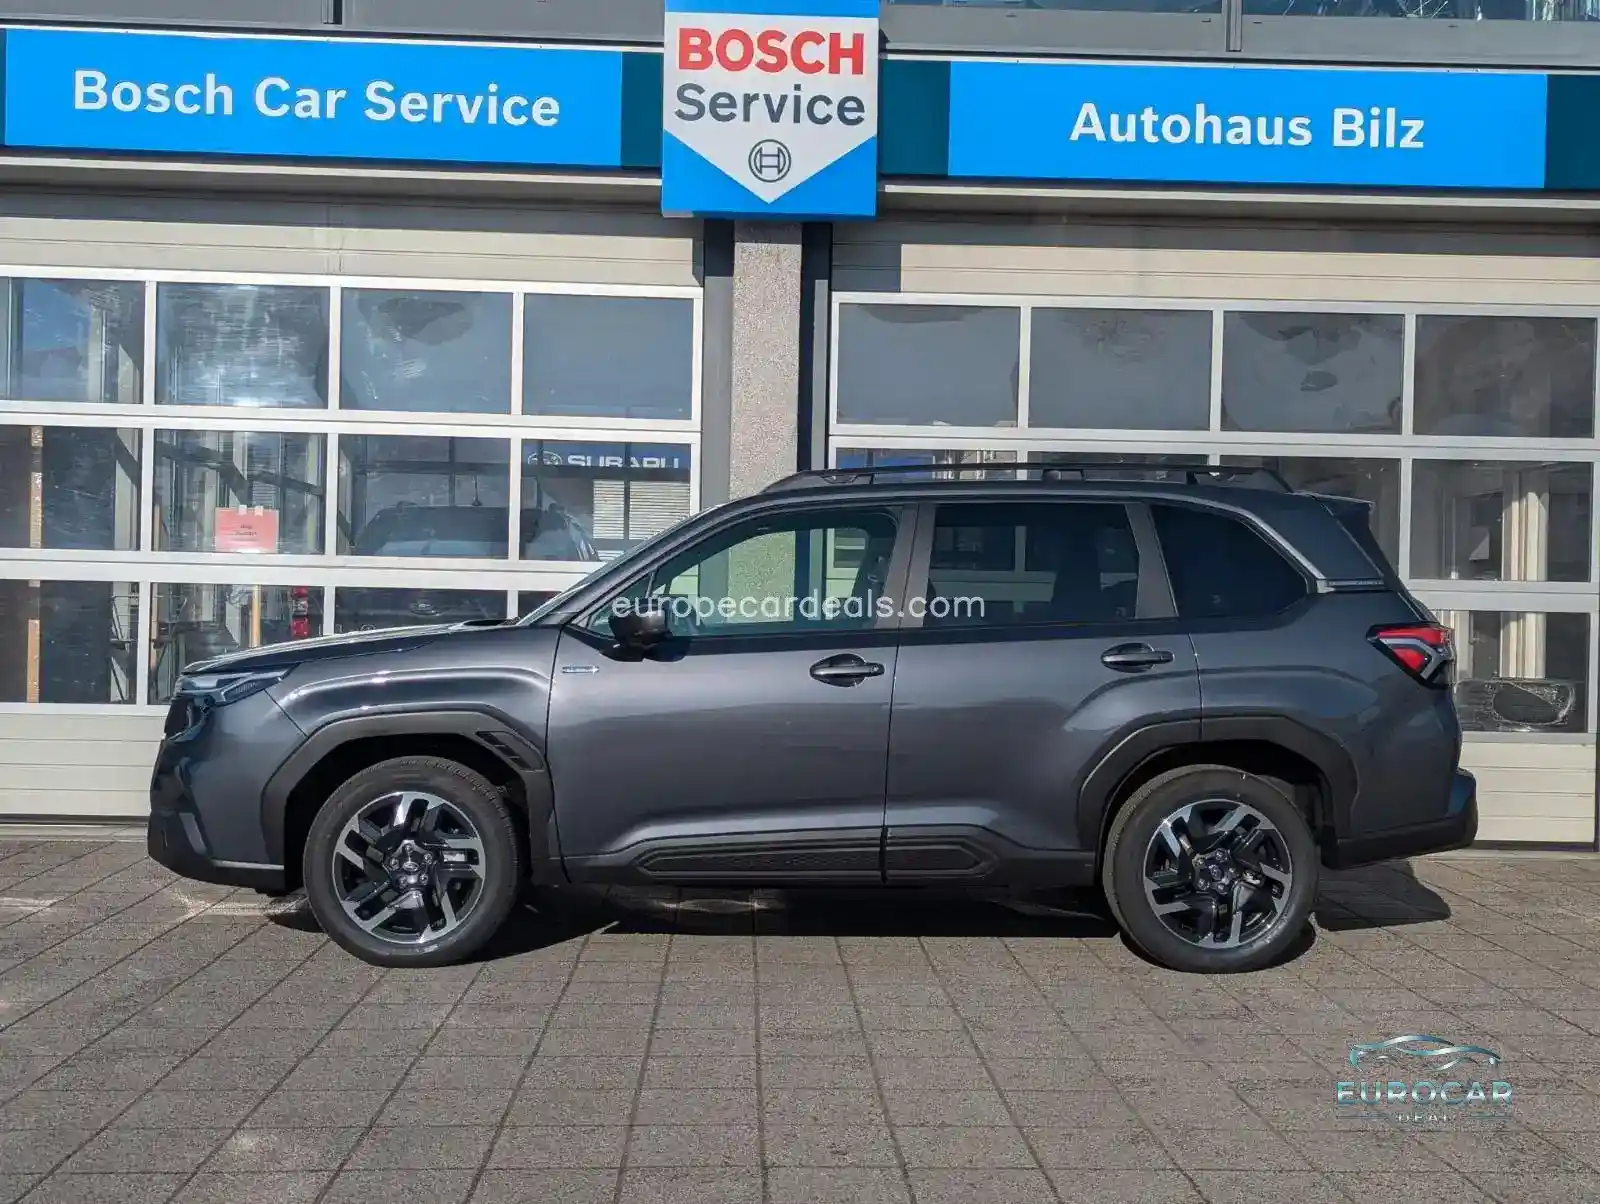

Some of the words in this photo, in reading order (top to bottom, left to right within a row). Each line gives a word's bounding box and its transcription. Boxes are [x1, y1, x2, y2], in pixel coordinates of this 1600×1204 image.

[678, 27, 865, 75] BOSCH
[73, 69, 233, 115] Bosch
[255, 77, 347, 119] Car
[365, 81, 560, 127] Service
[674, 83, 866, 126] Service
[1069, 102, 1313, 147] Autohaus
[1332, 107, 1425, 149] Bilz
